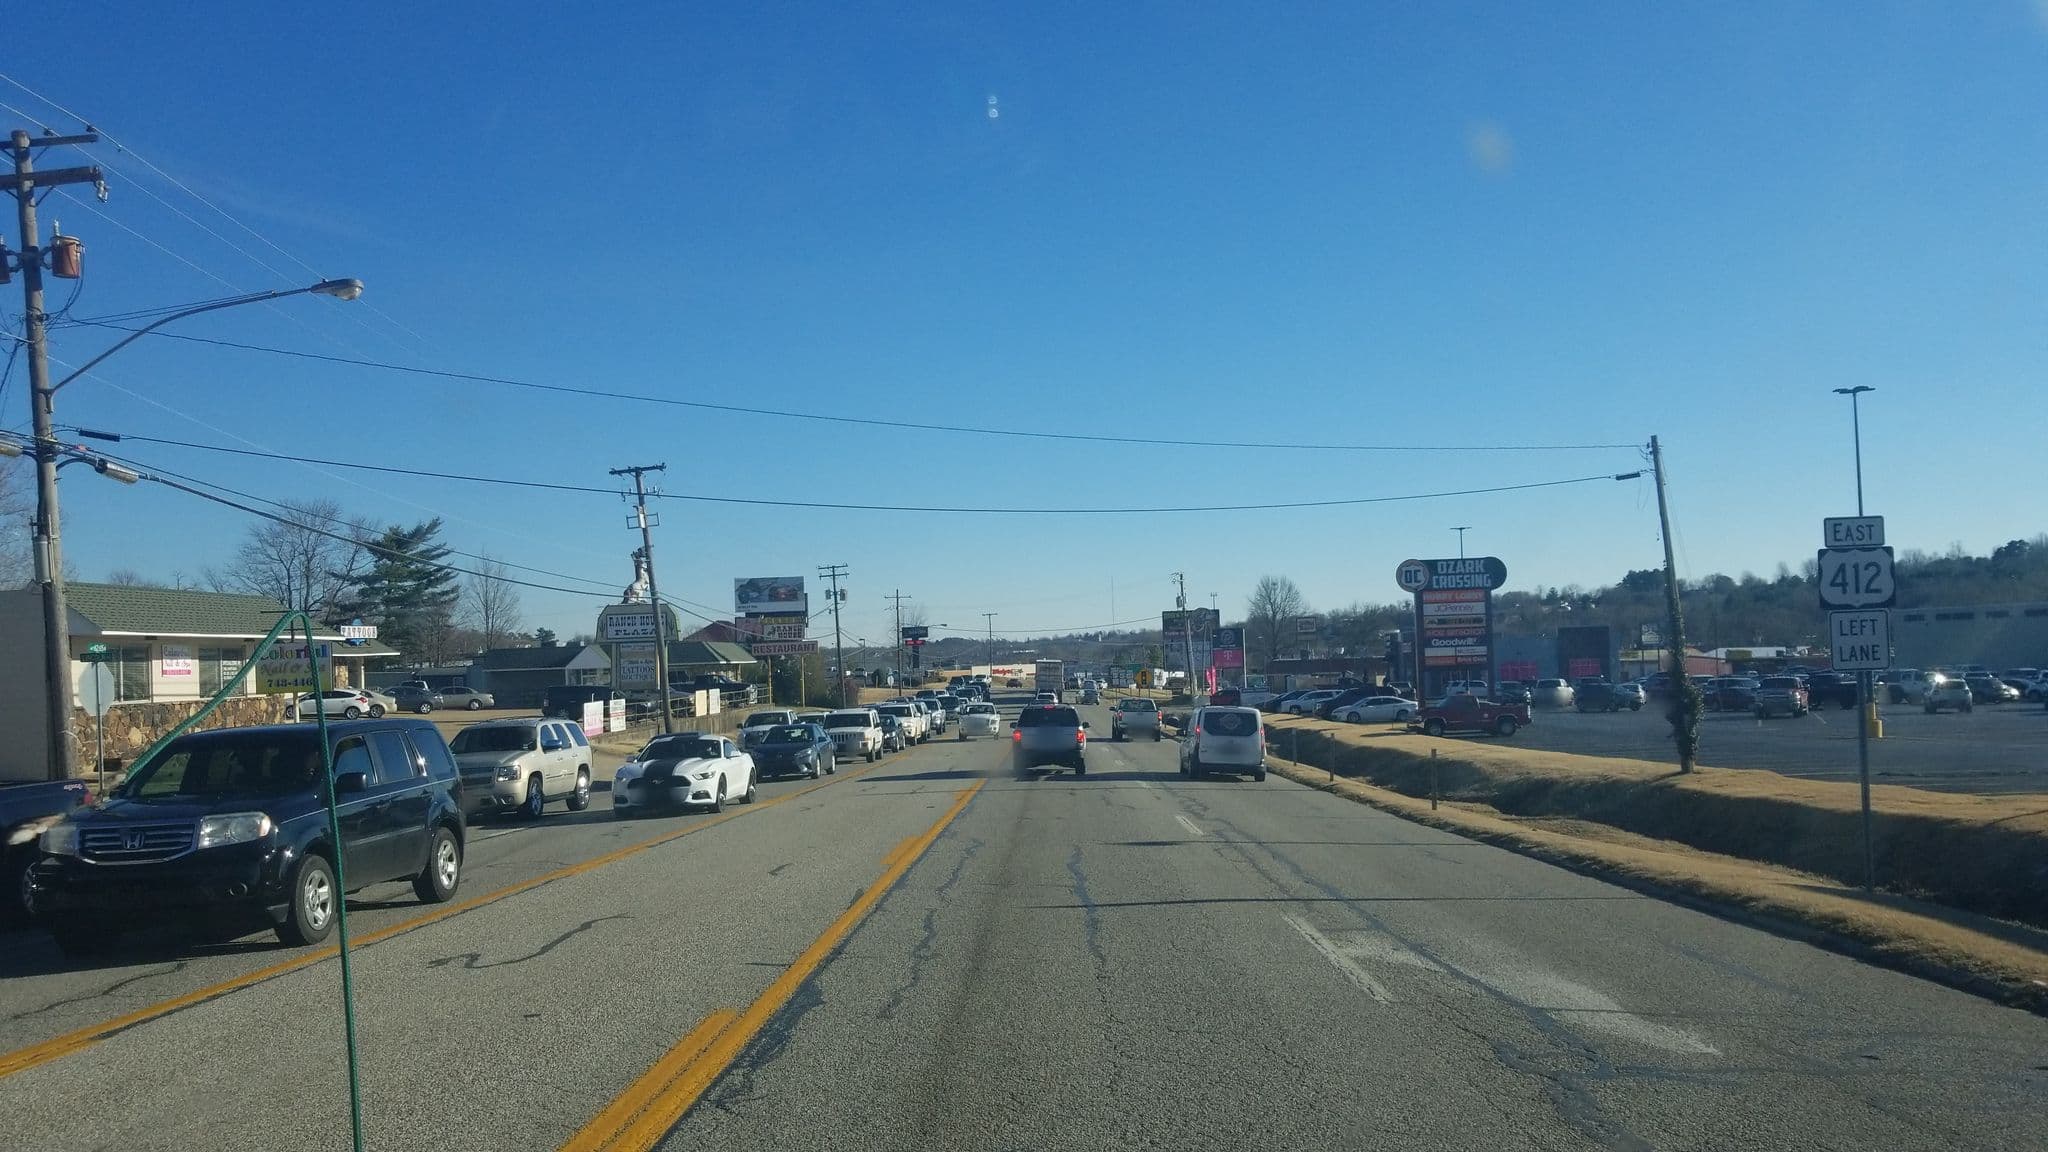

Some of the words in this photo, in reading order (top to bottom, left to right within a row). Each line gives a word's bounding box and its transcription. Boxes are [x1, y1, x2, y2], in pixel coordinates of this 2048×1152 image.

[1833, 523, 1874, 542] EAST
[1437, 560, 1485, 574] OZARK
[1404, 569, 1422, 584] OC
[1432, 574, 1492, 588] CROSSING
[1830, 562, 1882, 594] 412
[608, 615, 637, 627] RANCH
[640, 615, 664, 626] HOUE
[1840, 619, 1878, 636] LEFT
[341, 627, 377, 638] TATTOOS
[614, 628, 656, 636] PLAZA
[753, 643, 816, 654] RESTAURANT
[1432, 638, 1473, 646] Goodwill
[1840, 644, 1880, 662] LANE
